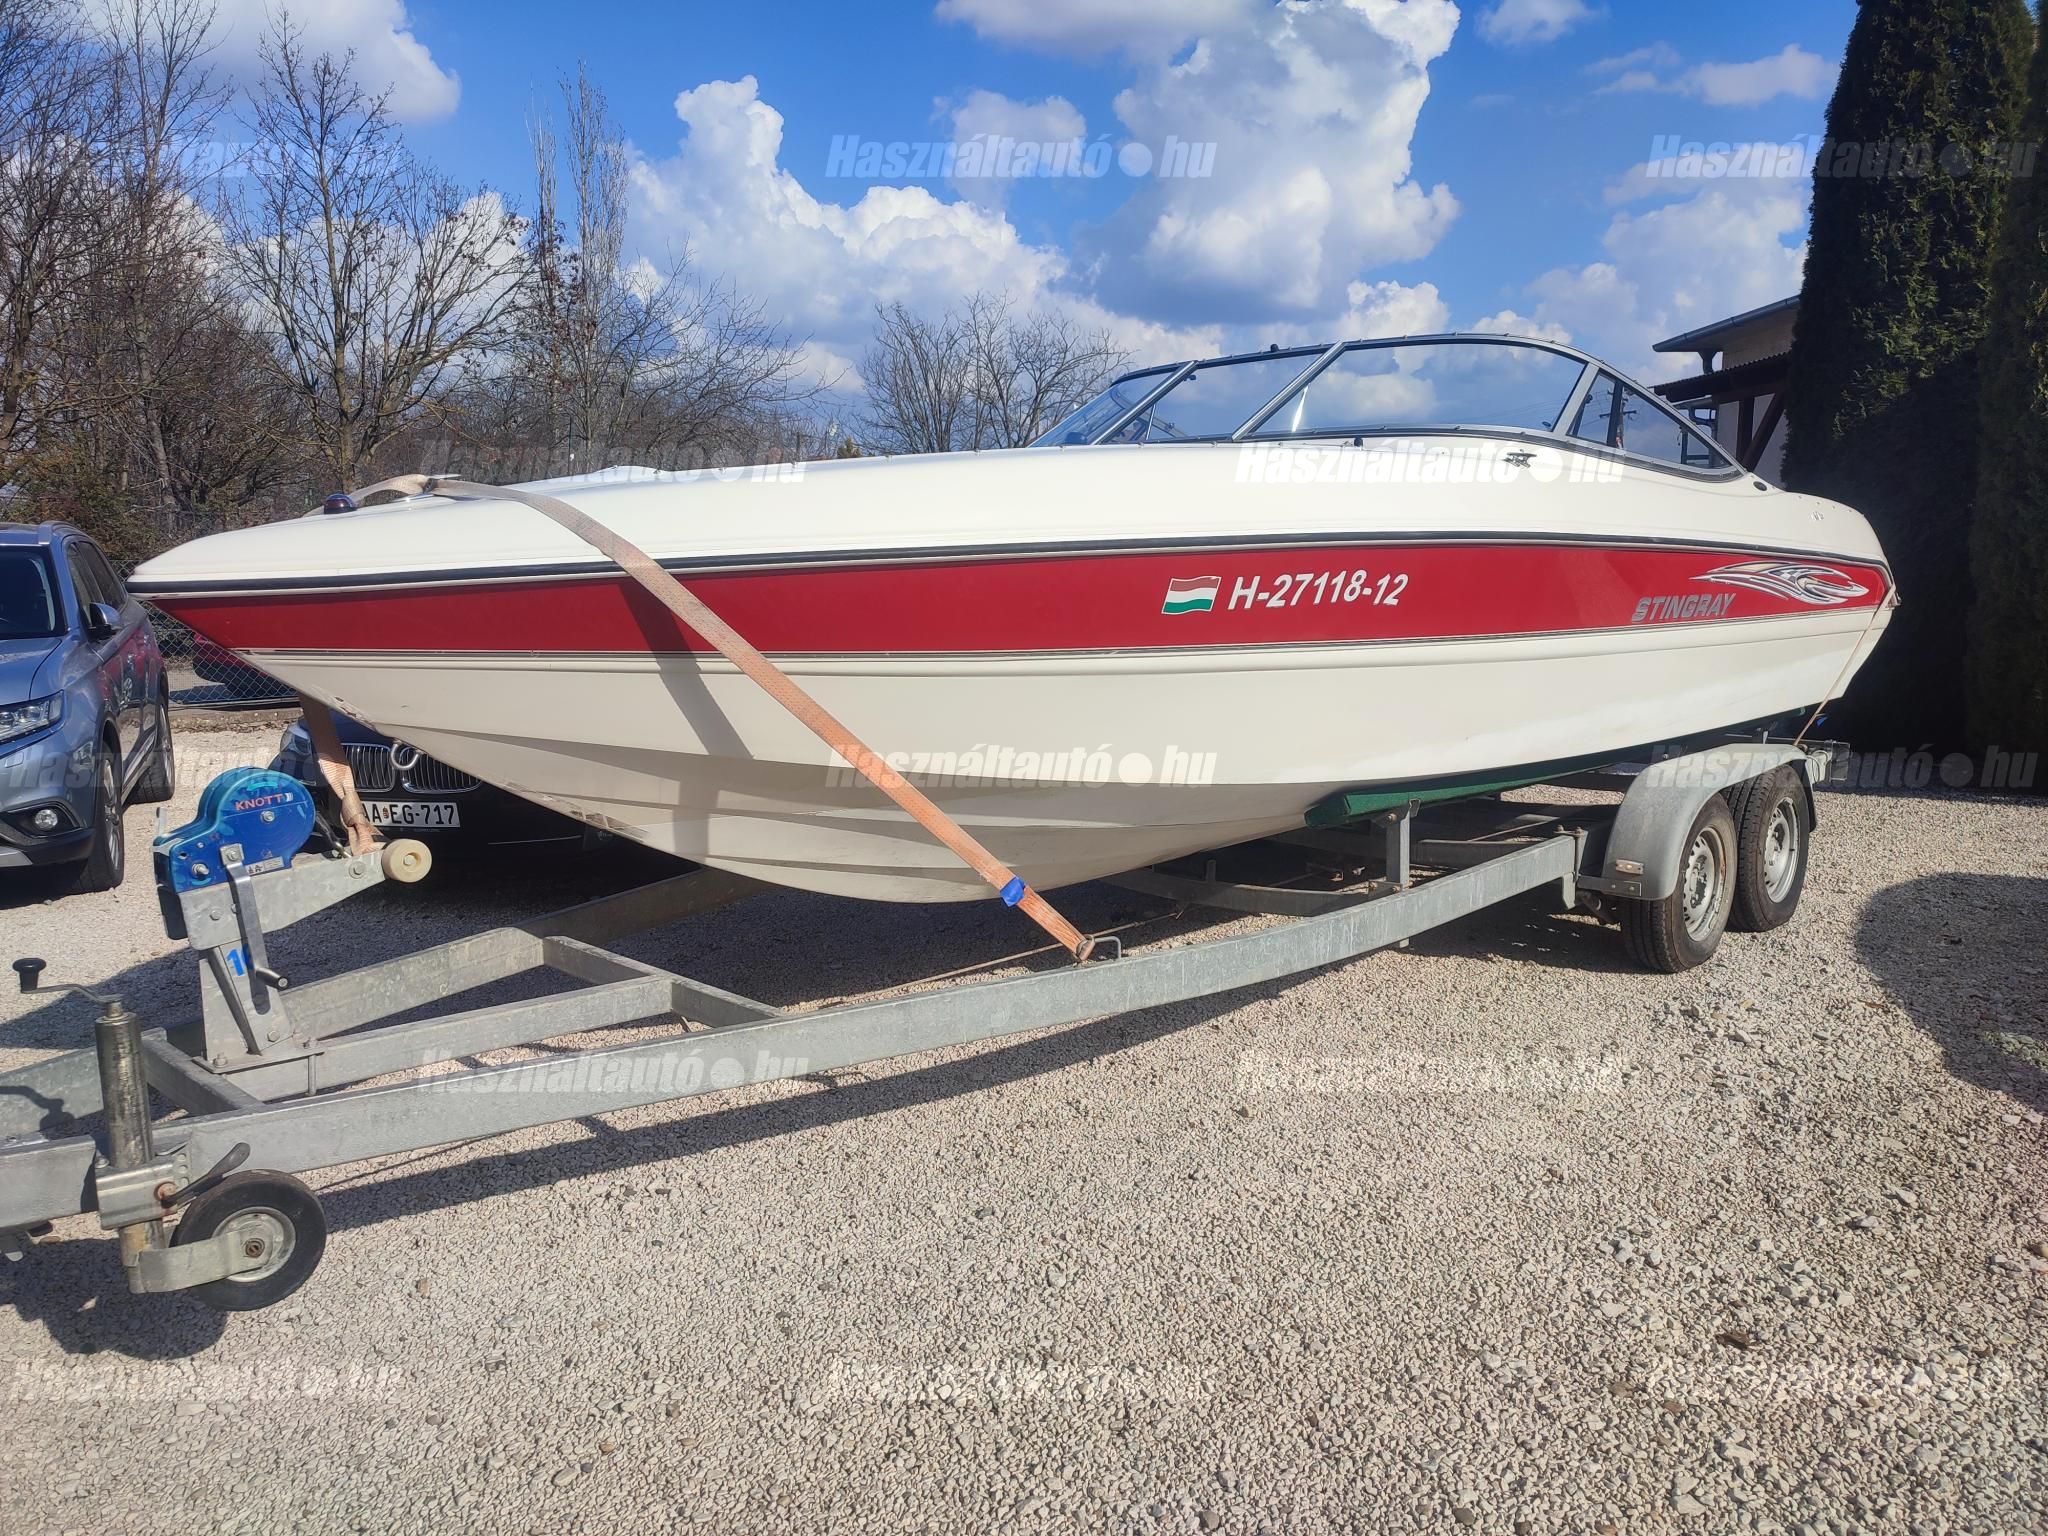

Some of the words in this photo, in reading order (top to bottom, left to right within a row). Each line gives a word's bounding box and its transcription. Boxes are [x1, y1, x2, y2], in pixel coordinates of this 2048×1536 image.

[1228, 569, 1409, 610] H-27118-12
[1631, 593, 1736, 623] STINGRAY
[235, 793, 283, 812] KNOTT
[389, 804, 454, 825] EG-717
